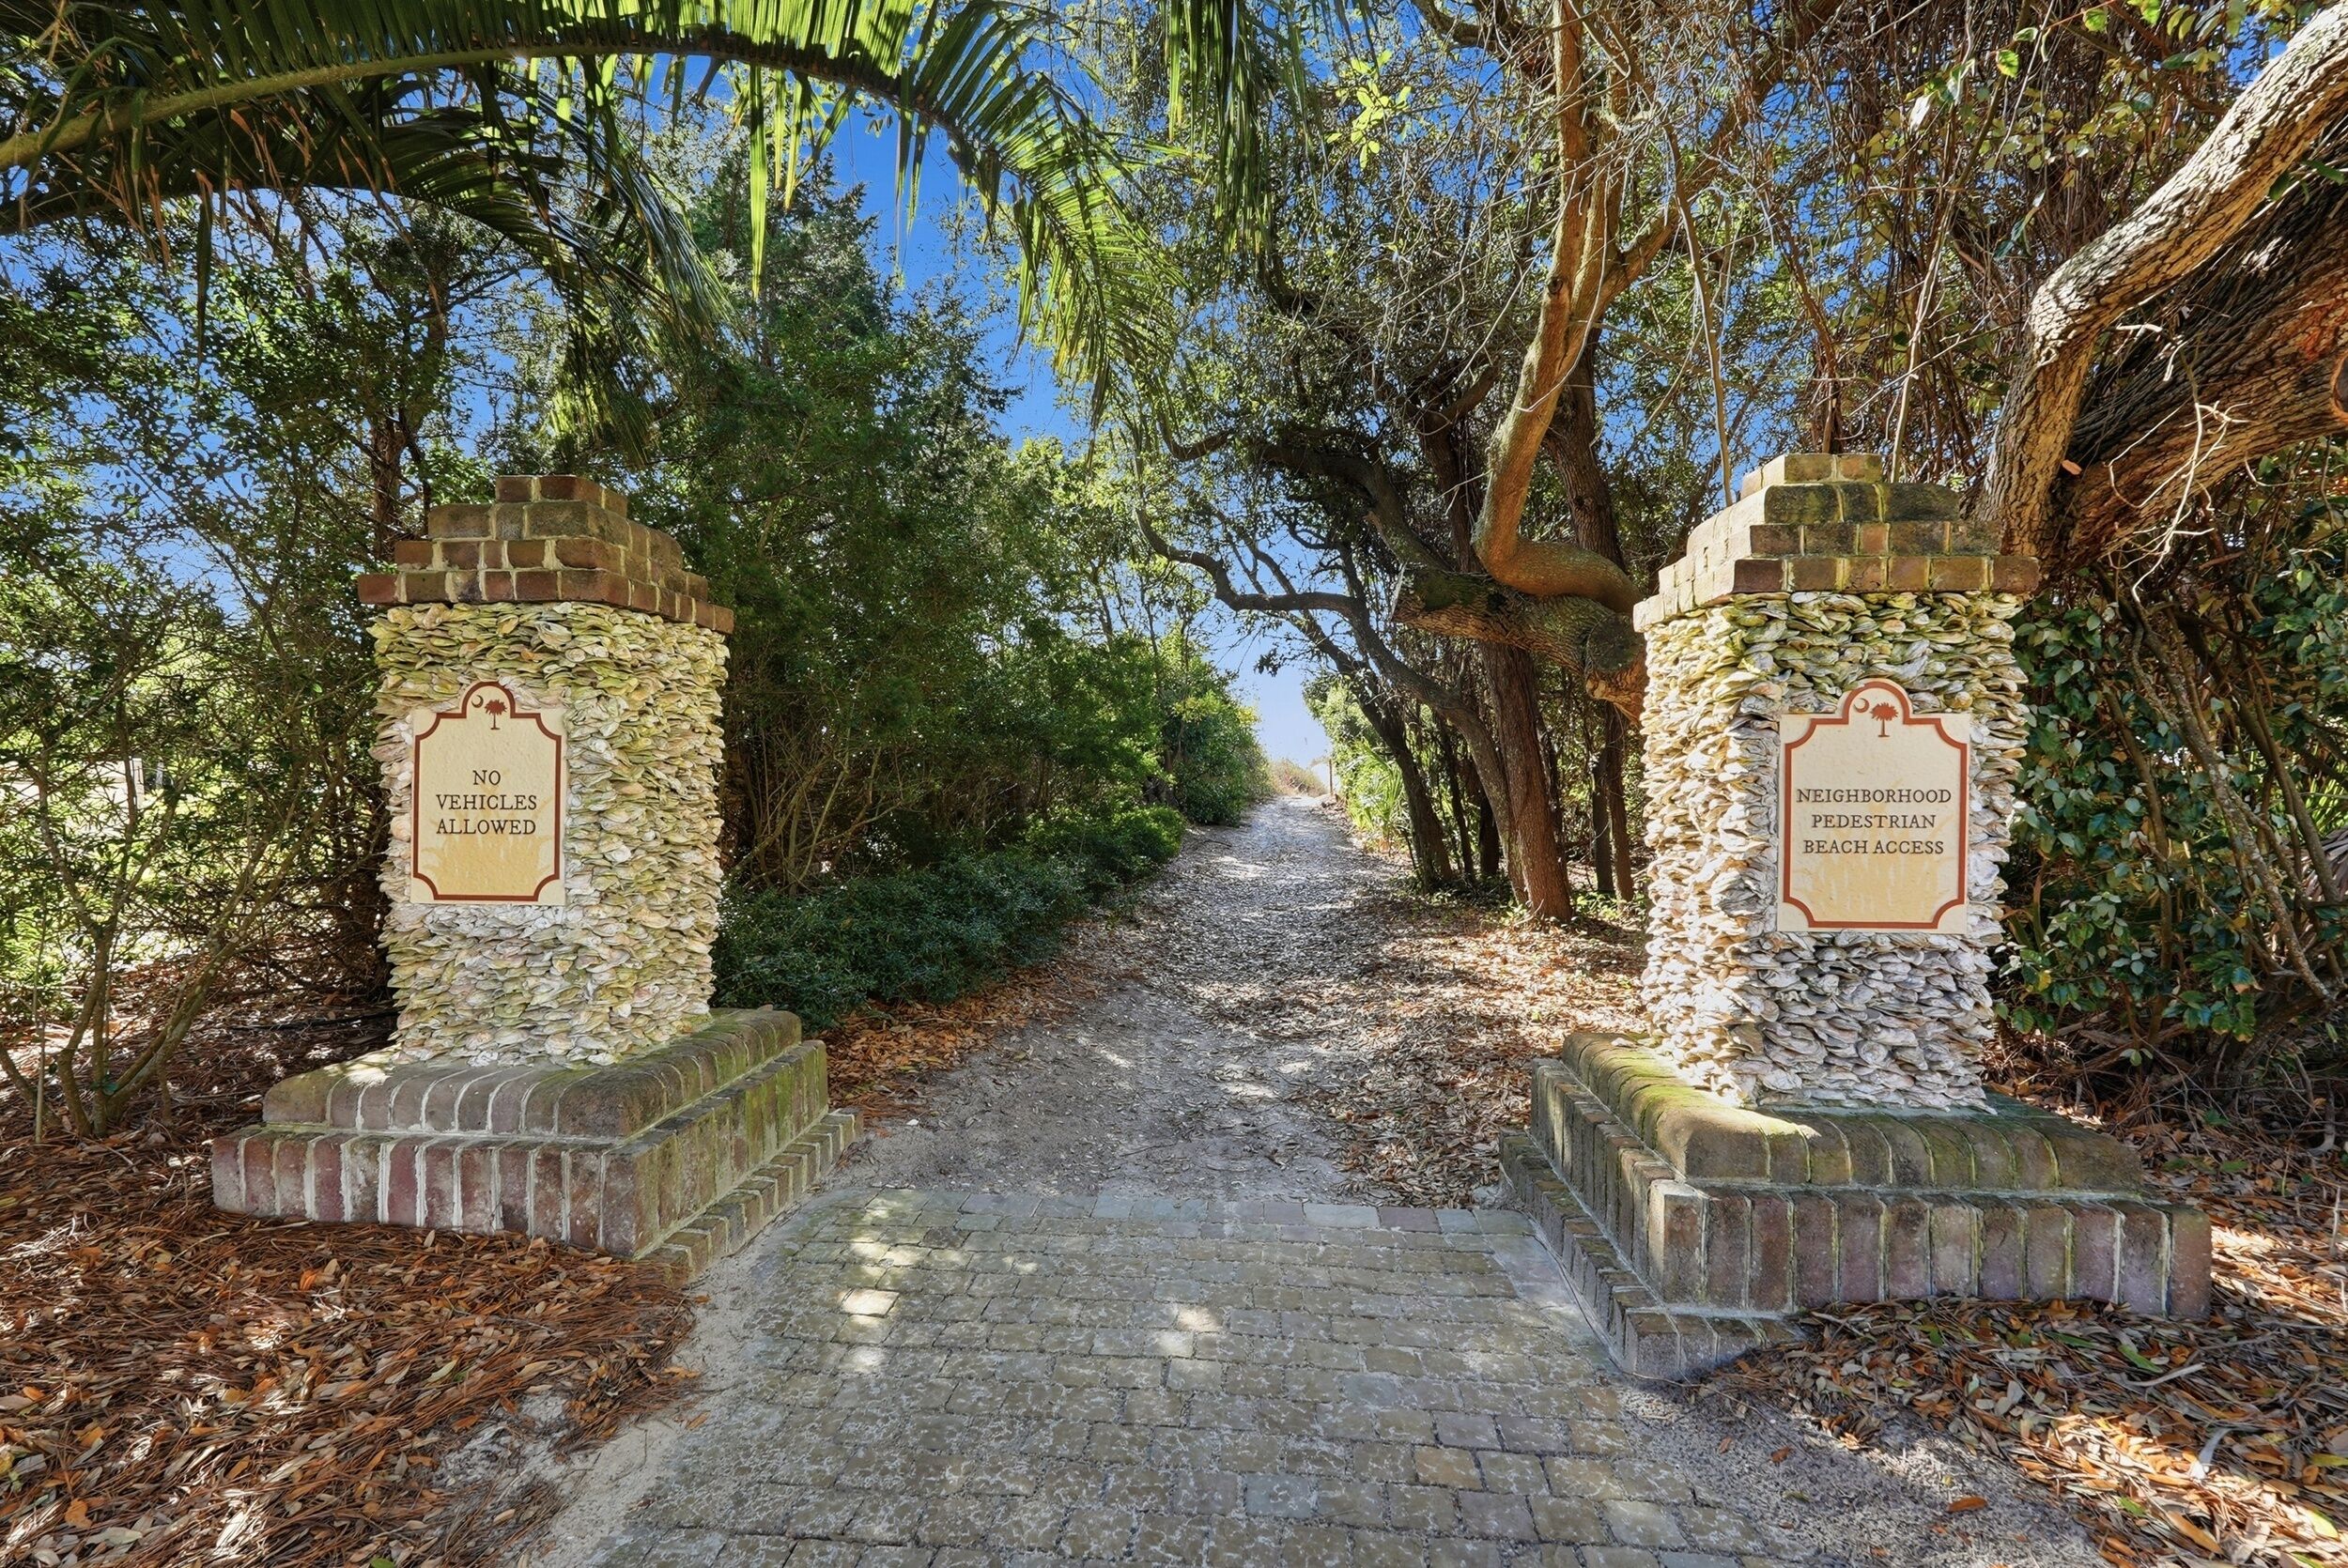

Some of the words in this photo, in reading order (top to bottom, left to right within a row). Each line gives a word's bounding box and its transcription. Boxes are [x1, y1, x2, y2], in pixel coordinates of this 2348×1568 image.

[472, 770, 501, 786] NO
[436, 794, 537, 810] VEHICLES
[1796, 789, 1952, 803] NEIGHBORHOOD
[436, 819, 536, 835] ALLOWED
[1811, 814, 1936, 828] PEDESTRIAN
[1801, 839, 1868, 853] BEACH
[1872, 839, 1944, 854] ACCESS
